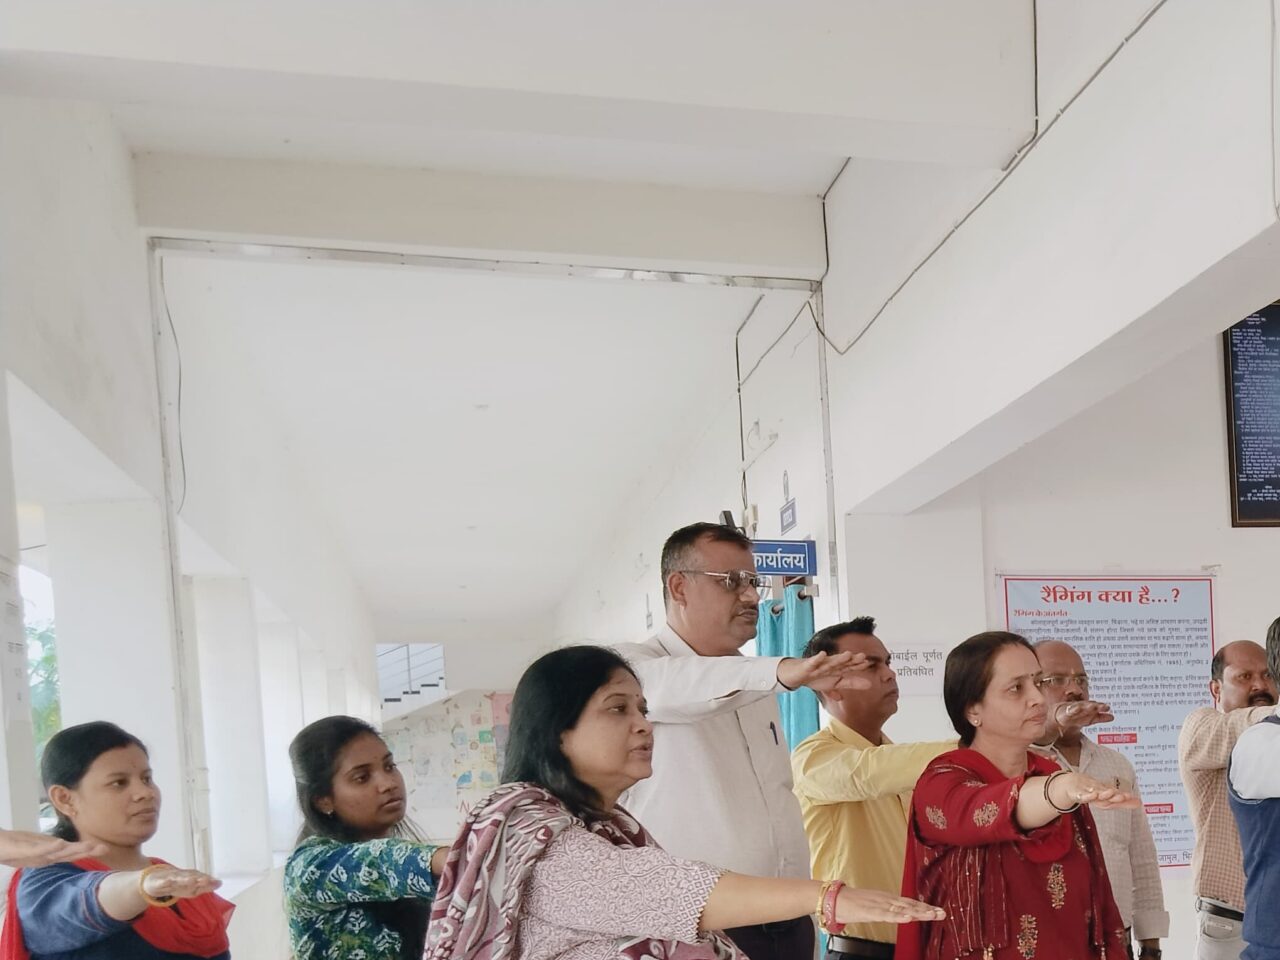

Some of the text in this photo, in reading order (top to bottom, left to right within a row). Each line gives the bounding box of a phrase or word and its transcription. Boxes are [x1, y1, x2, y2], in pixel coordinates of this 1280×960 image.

[1040, 585, 1092, 603] रैगिंग
[1098, 590, 1132, 603] क्या
[889, 649, 918, 661] ोबाईल
